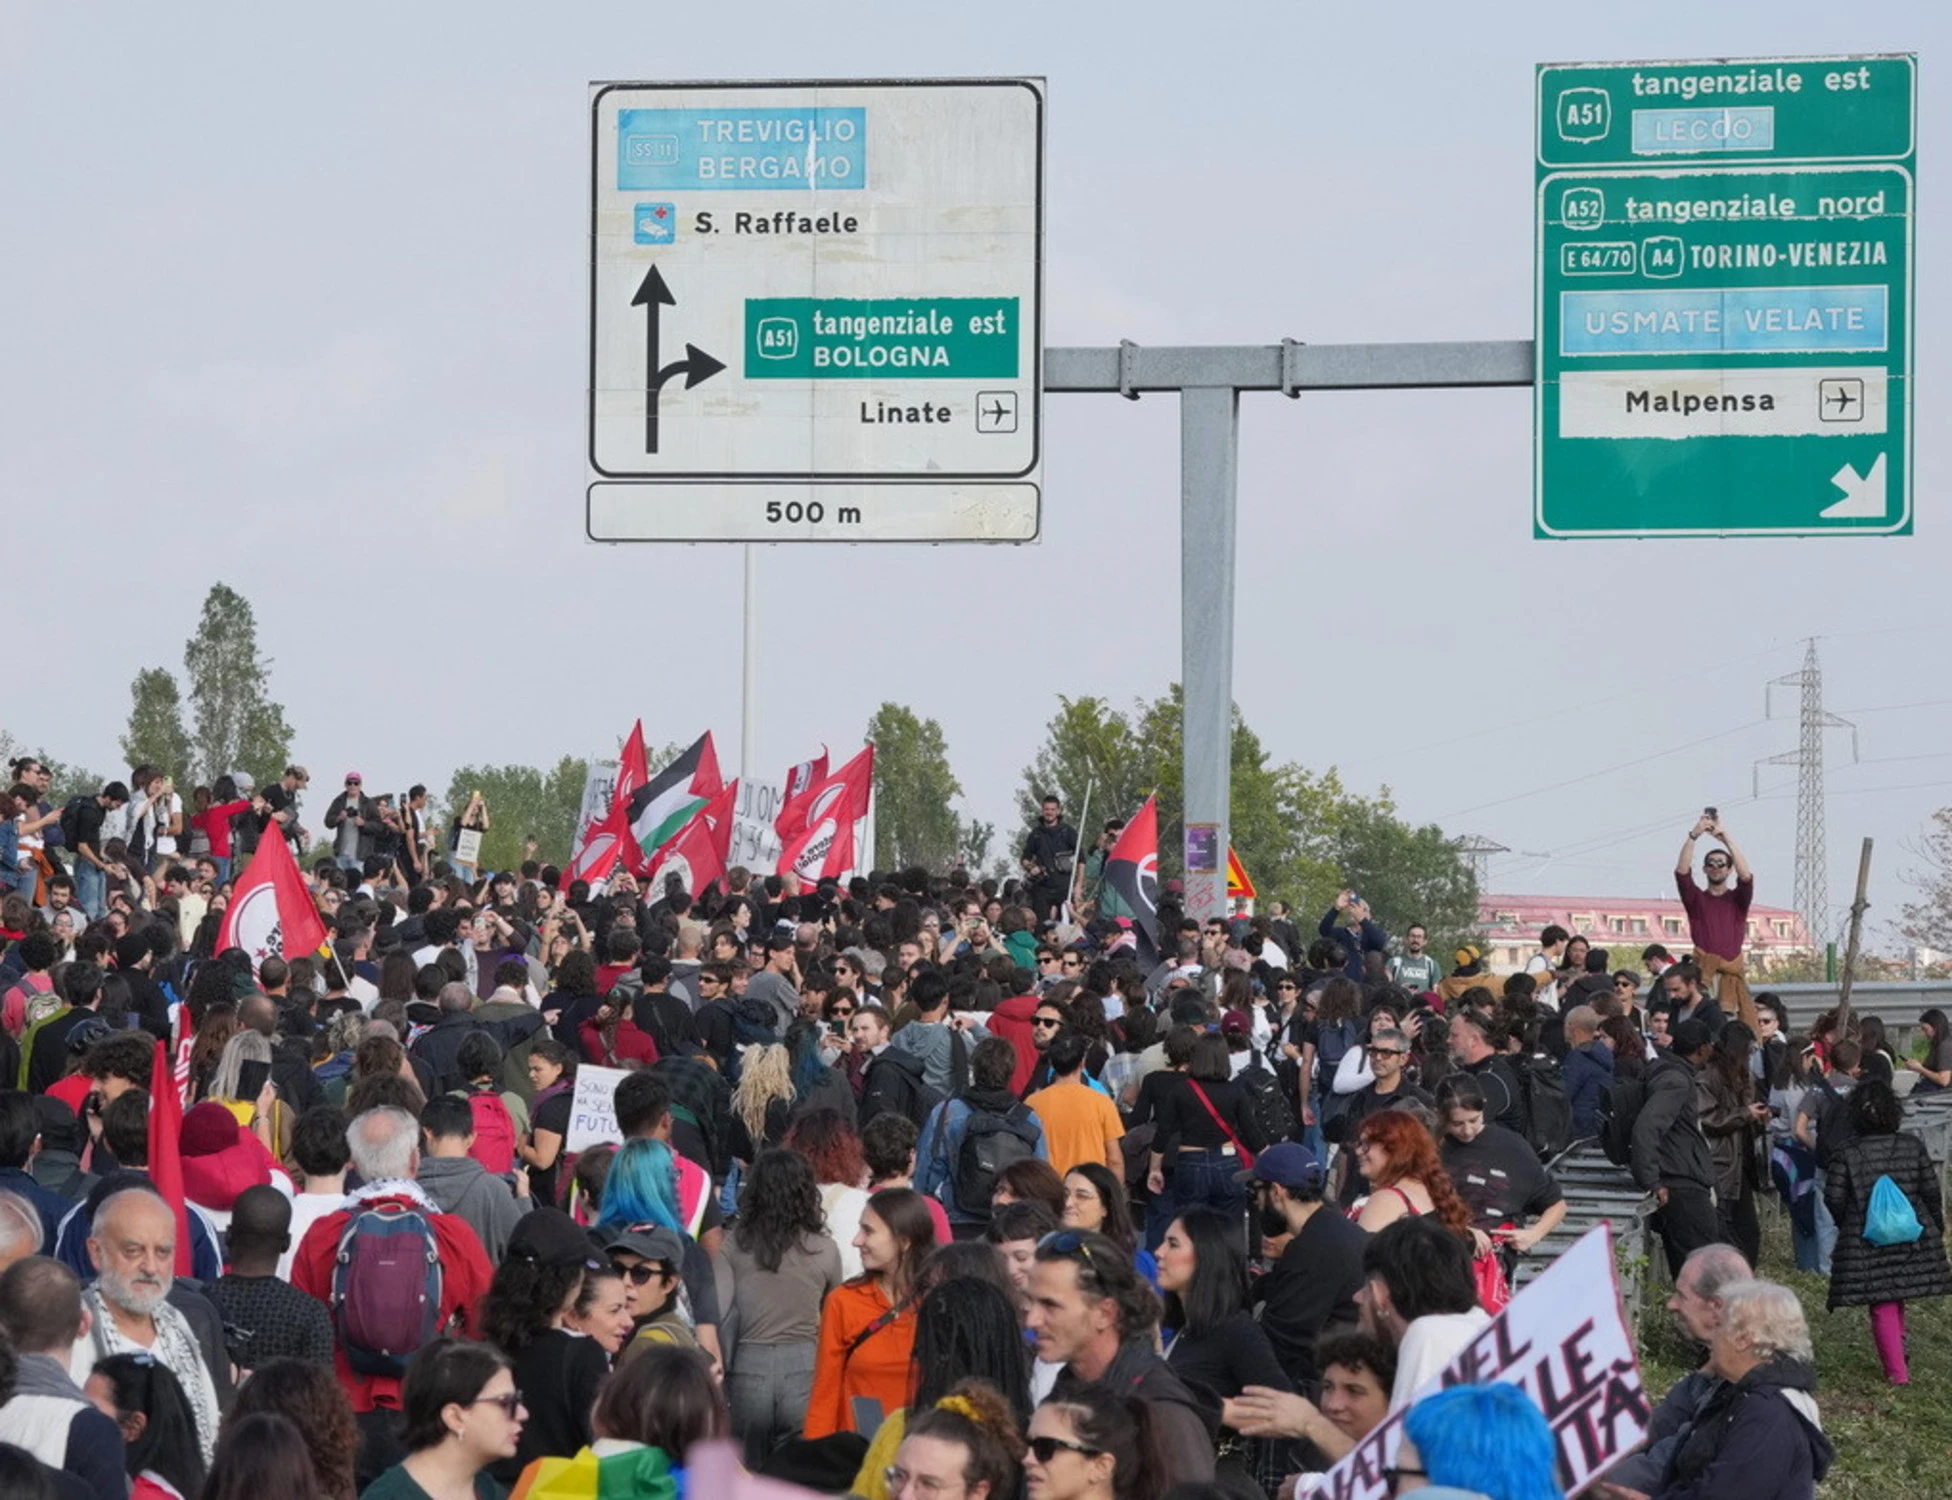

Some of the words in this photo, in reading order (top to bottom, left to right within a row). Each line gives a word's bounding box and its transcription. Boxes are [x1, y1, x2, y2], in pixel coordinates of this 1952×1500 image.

[1632, 69, 1802, 99] tangenziale
[1824, 67, 1870, 90] est
[1567, 104, 1602, 125] A51
[697, 119, 855, 143] TREVIGLIO
[1656, 119, 1752, 141] LECCO
[635, 143, 651, 156] SS
[699, 156, 850, 179] BERGAMO
[1567, 200, 1599, 218] A52
[1625, 194, 1796, 224] tangenziale
[1818, 190, 1886, 216] nord
[695, 211, 719, 233] S.
[735, 211, 858, 234] Raffaele
[1567, 251, 1575, 267] E
[1581, 249, 1631, 267] 64/70
[1652, 248, 1674, 266] A4
[1691, 241, 1887, 269] TORINO-VENEZIA
[813, 309, 954, 341] tangenziale
[969, 309, 1007, 335] est
[1585, 310, 1720, 335] USMATE
[1745, 307, 1865, 332] VELATE
[764, 329, 794, 347] A51
[813, 346, 951, 368] BOLOGNA
[861, 402, 953, 424] Linate
[1626, 390, 1775, 416] Malpensa
[766, 501, 825, 523] 500
[838, 507, 862, 523] m
